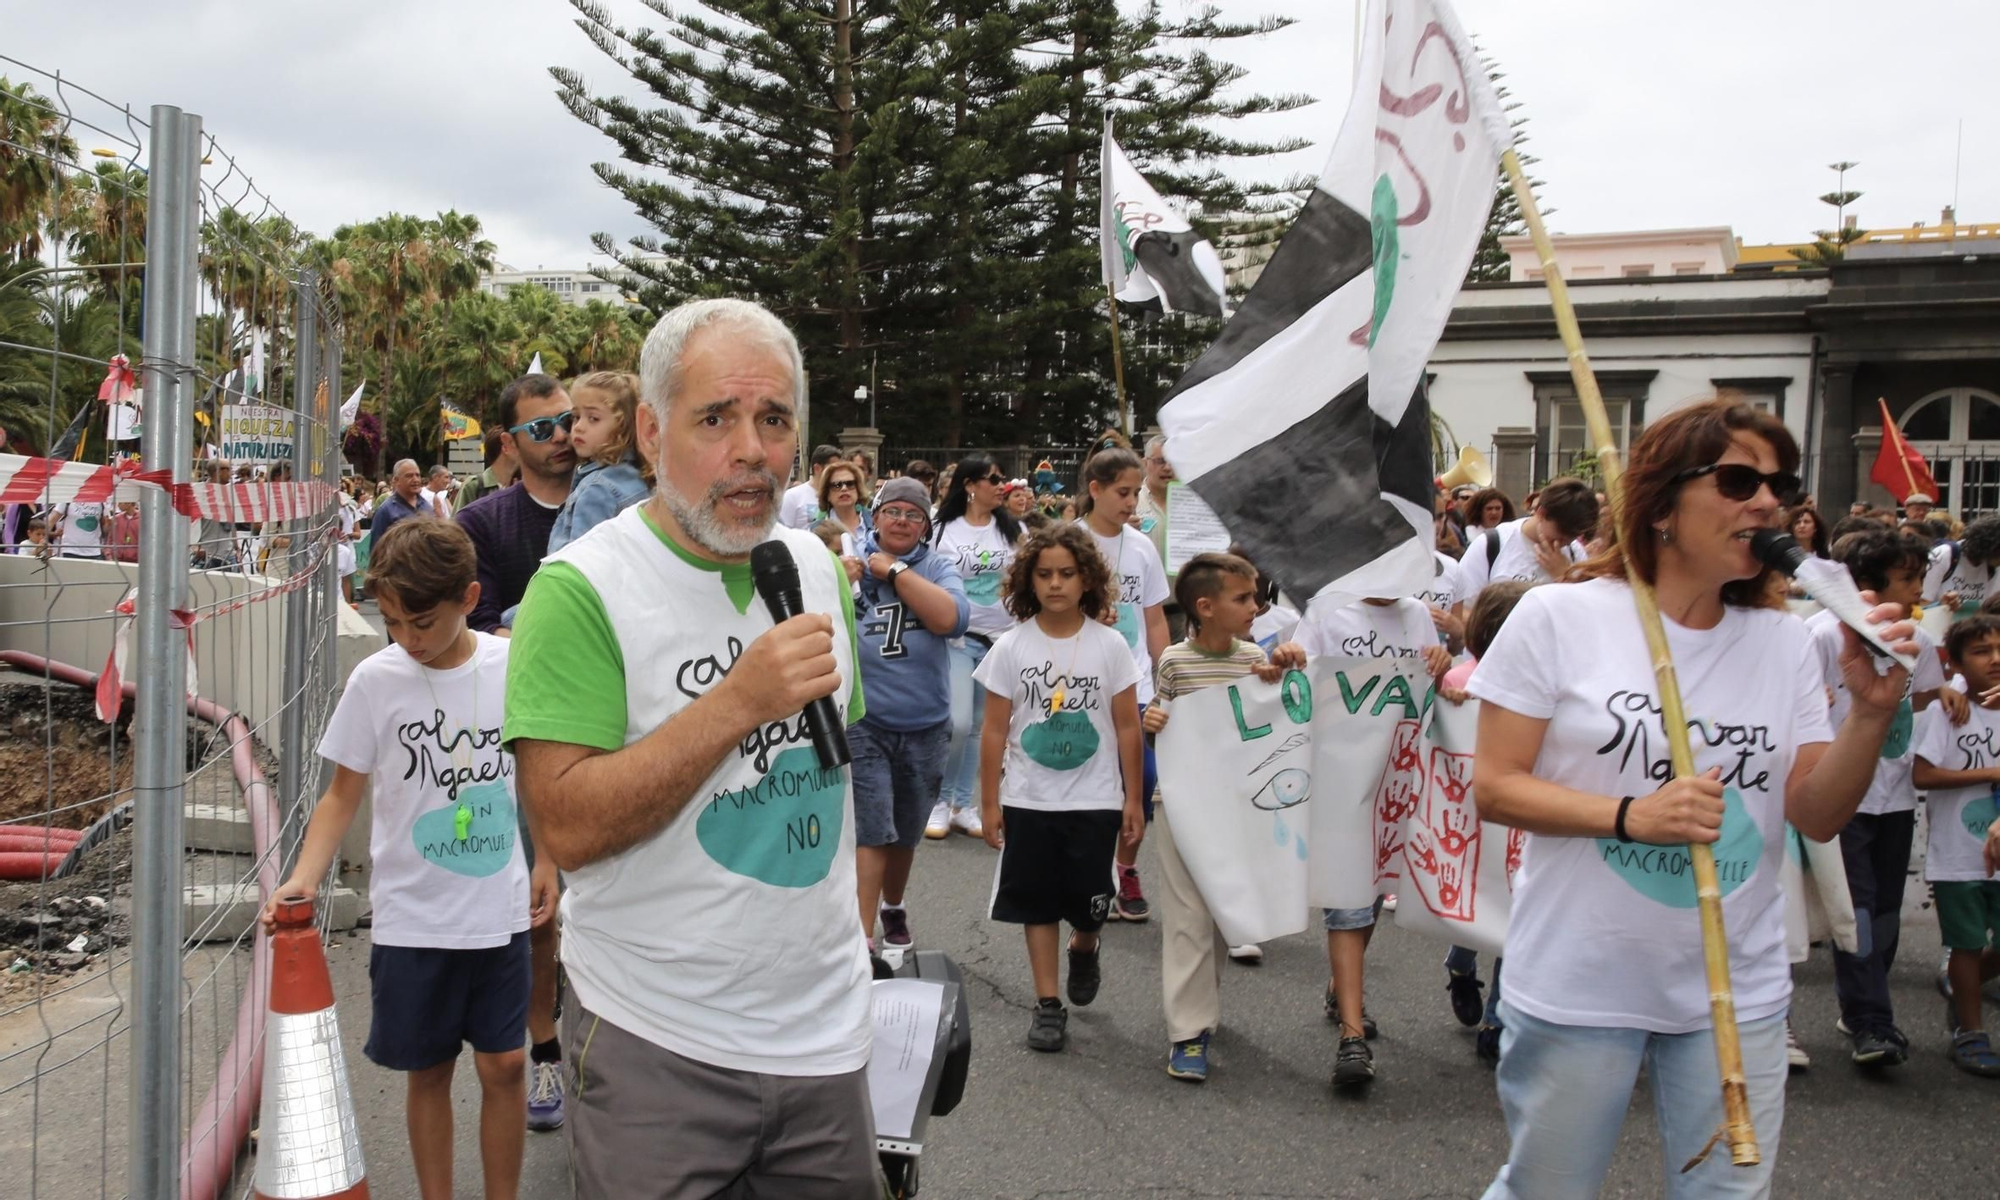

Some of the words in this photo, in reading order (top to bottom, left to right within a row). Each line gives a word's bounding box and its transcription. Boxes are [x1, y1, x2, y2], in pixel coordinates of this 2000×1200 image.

[241, 407, 280, 418] NUESTRA
[224, 418, 294, 438] RIQUEZA
[874, 602, 903, 657] 7
[1227, 669, 1312, 741] LO
[1052, 741, 1072, 757] NO
[786, 813, 821, 854] NO
